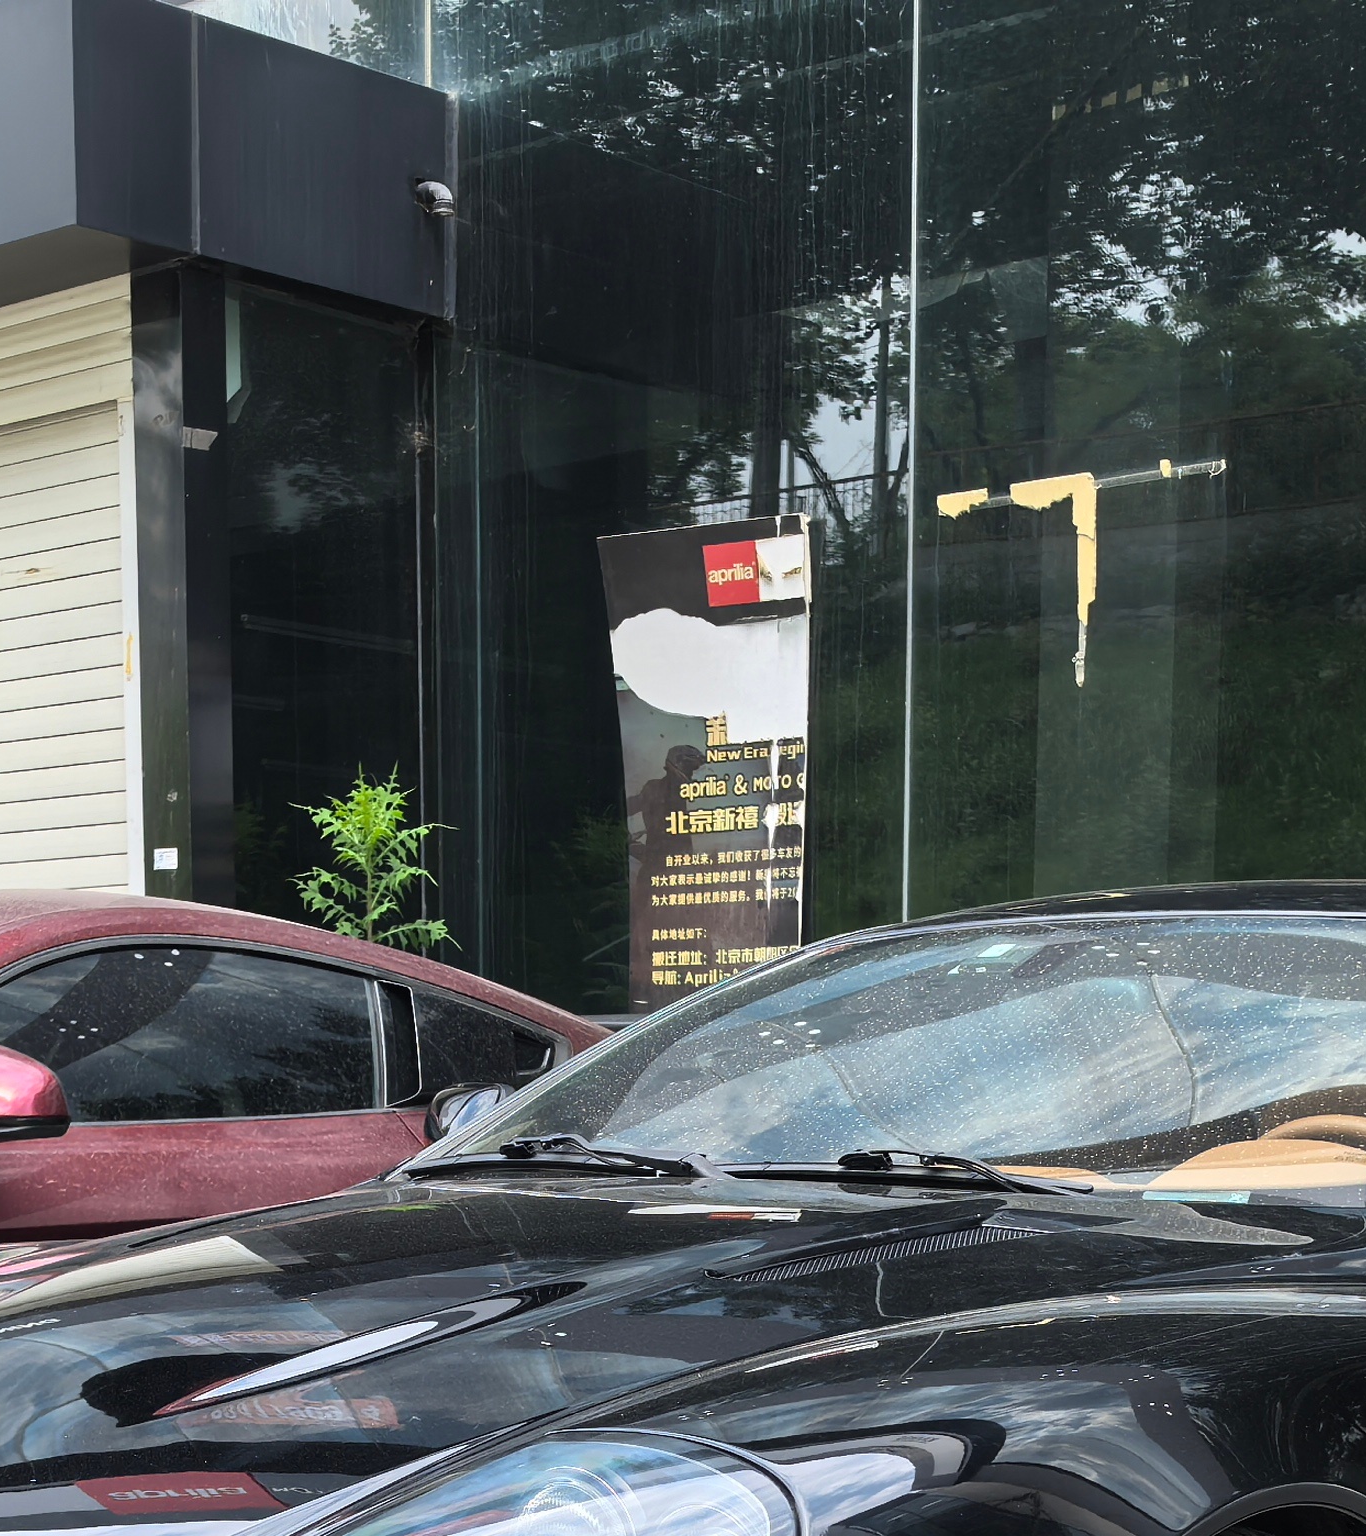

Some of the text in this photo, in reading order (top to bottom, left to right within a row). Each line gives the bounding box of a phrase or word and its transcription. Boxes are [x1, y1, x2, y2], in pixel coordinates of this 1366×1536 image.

[708, 562, 754, 586] aprilia
[706, 749, 742, 762] New
[743, 746, 769, 759] Era
[679, 775, 727, 801] aprilia
[734, 774, 749, 796] &
[664, 805, 760, 835] 北京新禧
